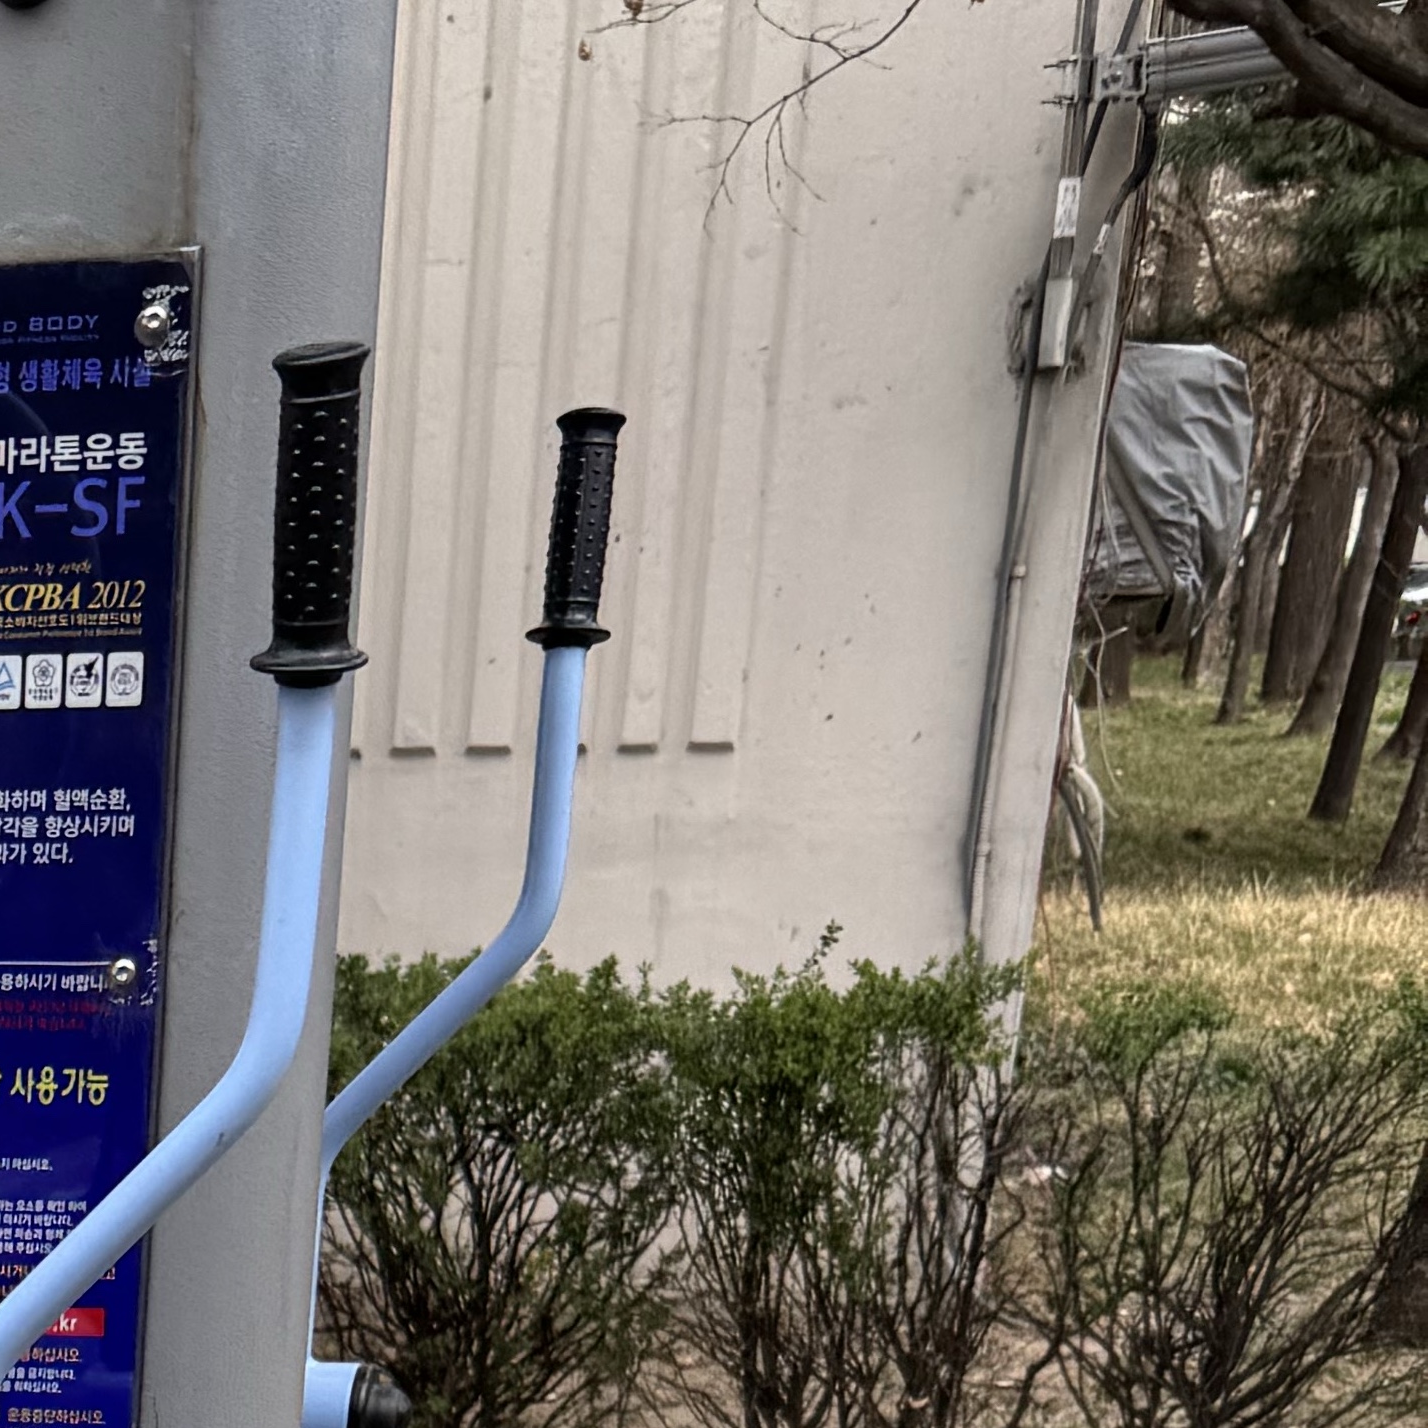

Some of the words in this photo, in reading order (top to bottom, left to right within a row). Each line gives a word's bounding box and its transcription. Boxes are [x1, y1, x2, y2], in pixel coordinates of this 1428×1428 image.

[29, 314, 99, 332] BODY
[18, 357, 103, 392] 생활체육
[87, 579, 146, 610] 2012
[54, 789, 130, 811] 혈액순환,
[45, 816, 134, 837] 향상시키며
[33, 843, 73, 863] 있다.
[61, 975, 108, 992] 바랍니
[11, 1067, 108, 1105] 사용가능
